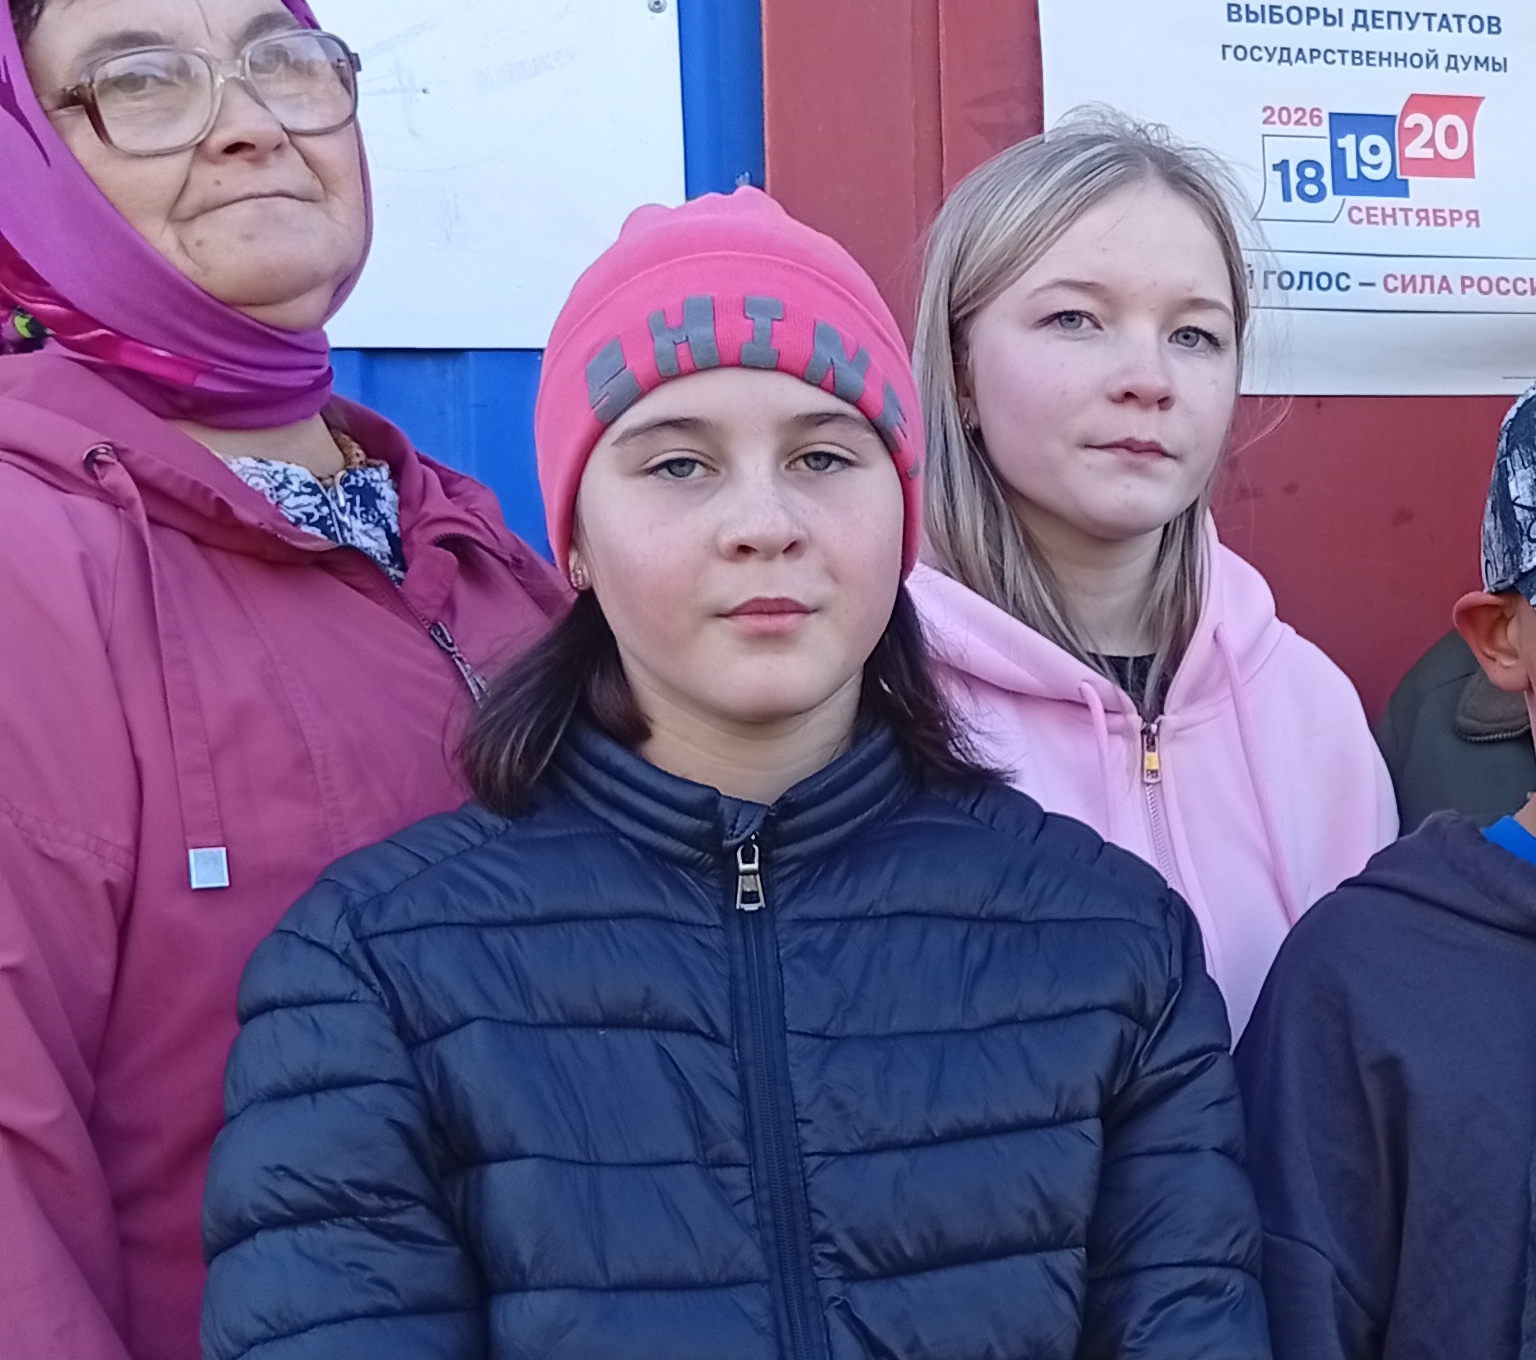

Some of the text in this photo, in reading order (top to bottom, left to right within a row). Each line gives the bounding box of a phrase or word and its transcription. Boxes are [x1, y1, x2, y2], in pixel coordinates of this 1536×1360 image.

[1226, 2, 1502, 35] ВЫБОРЫ ДЕПУТАТОВ
[1221, 44, 1508, 73] ГОСУДАРСТВЕННОЙ ДУМЫ
[1262, 105, 1323, 128] 2026
[1271, 112, 1469, 204] 18 19 20
[1347, 205, 1480, 228] СЕНТЯБРЯ
[1263, 269, 1352, 293] ГОЛОС
[1382, 273, 1454, 295] СИЛА
